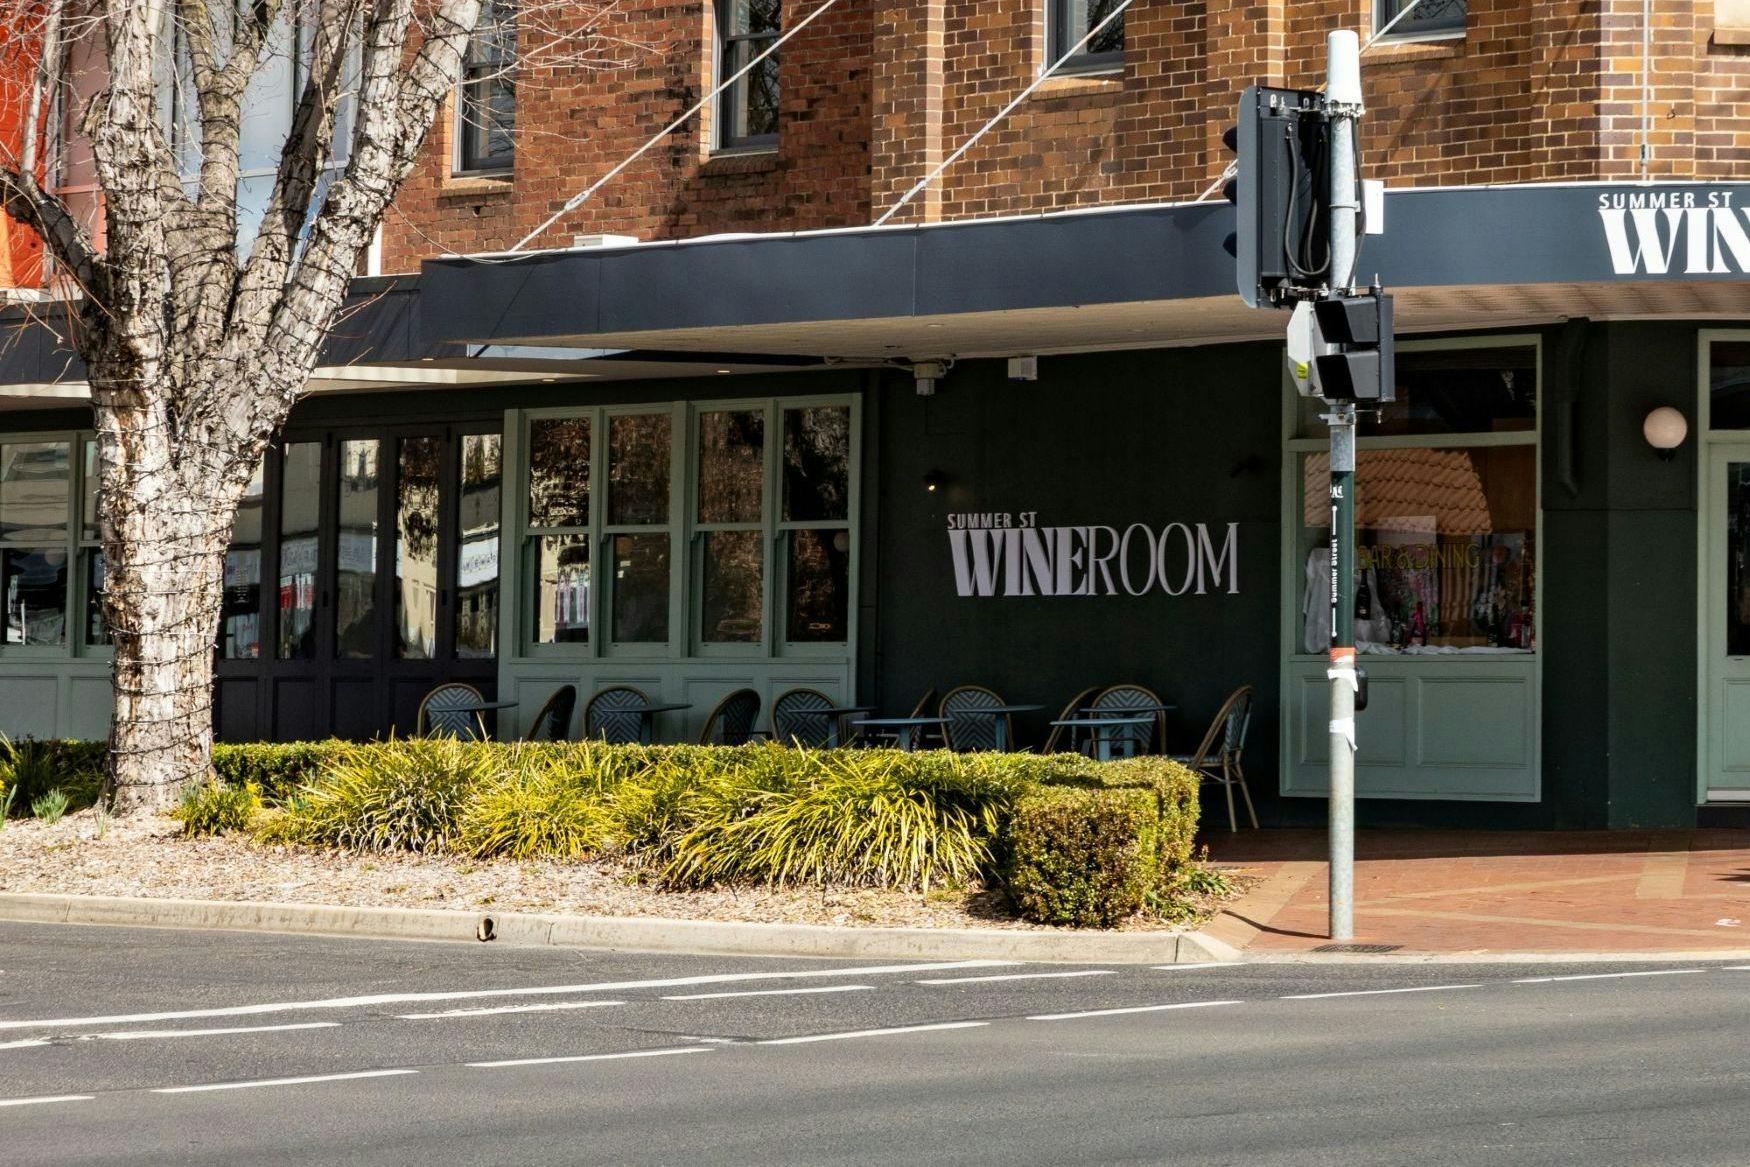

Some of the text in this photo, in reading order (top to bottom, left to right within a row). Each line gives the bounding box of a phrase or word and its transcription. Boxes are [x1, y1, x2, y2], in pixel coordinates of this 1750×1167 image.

[1598, 191, 1733, 209] SUMMER ST
[947, 511, 1038, 530] SUMMER ST
[947, 522, 1240, 597] WINEROOM
[1357, 543, 1480, 569] BAR & DINING
